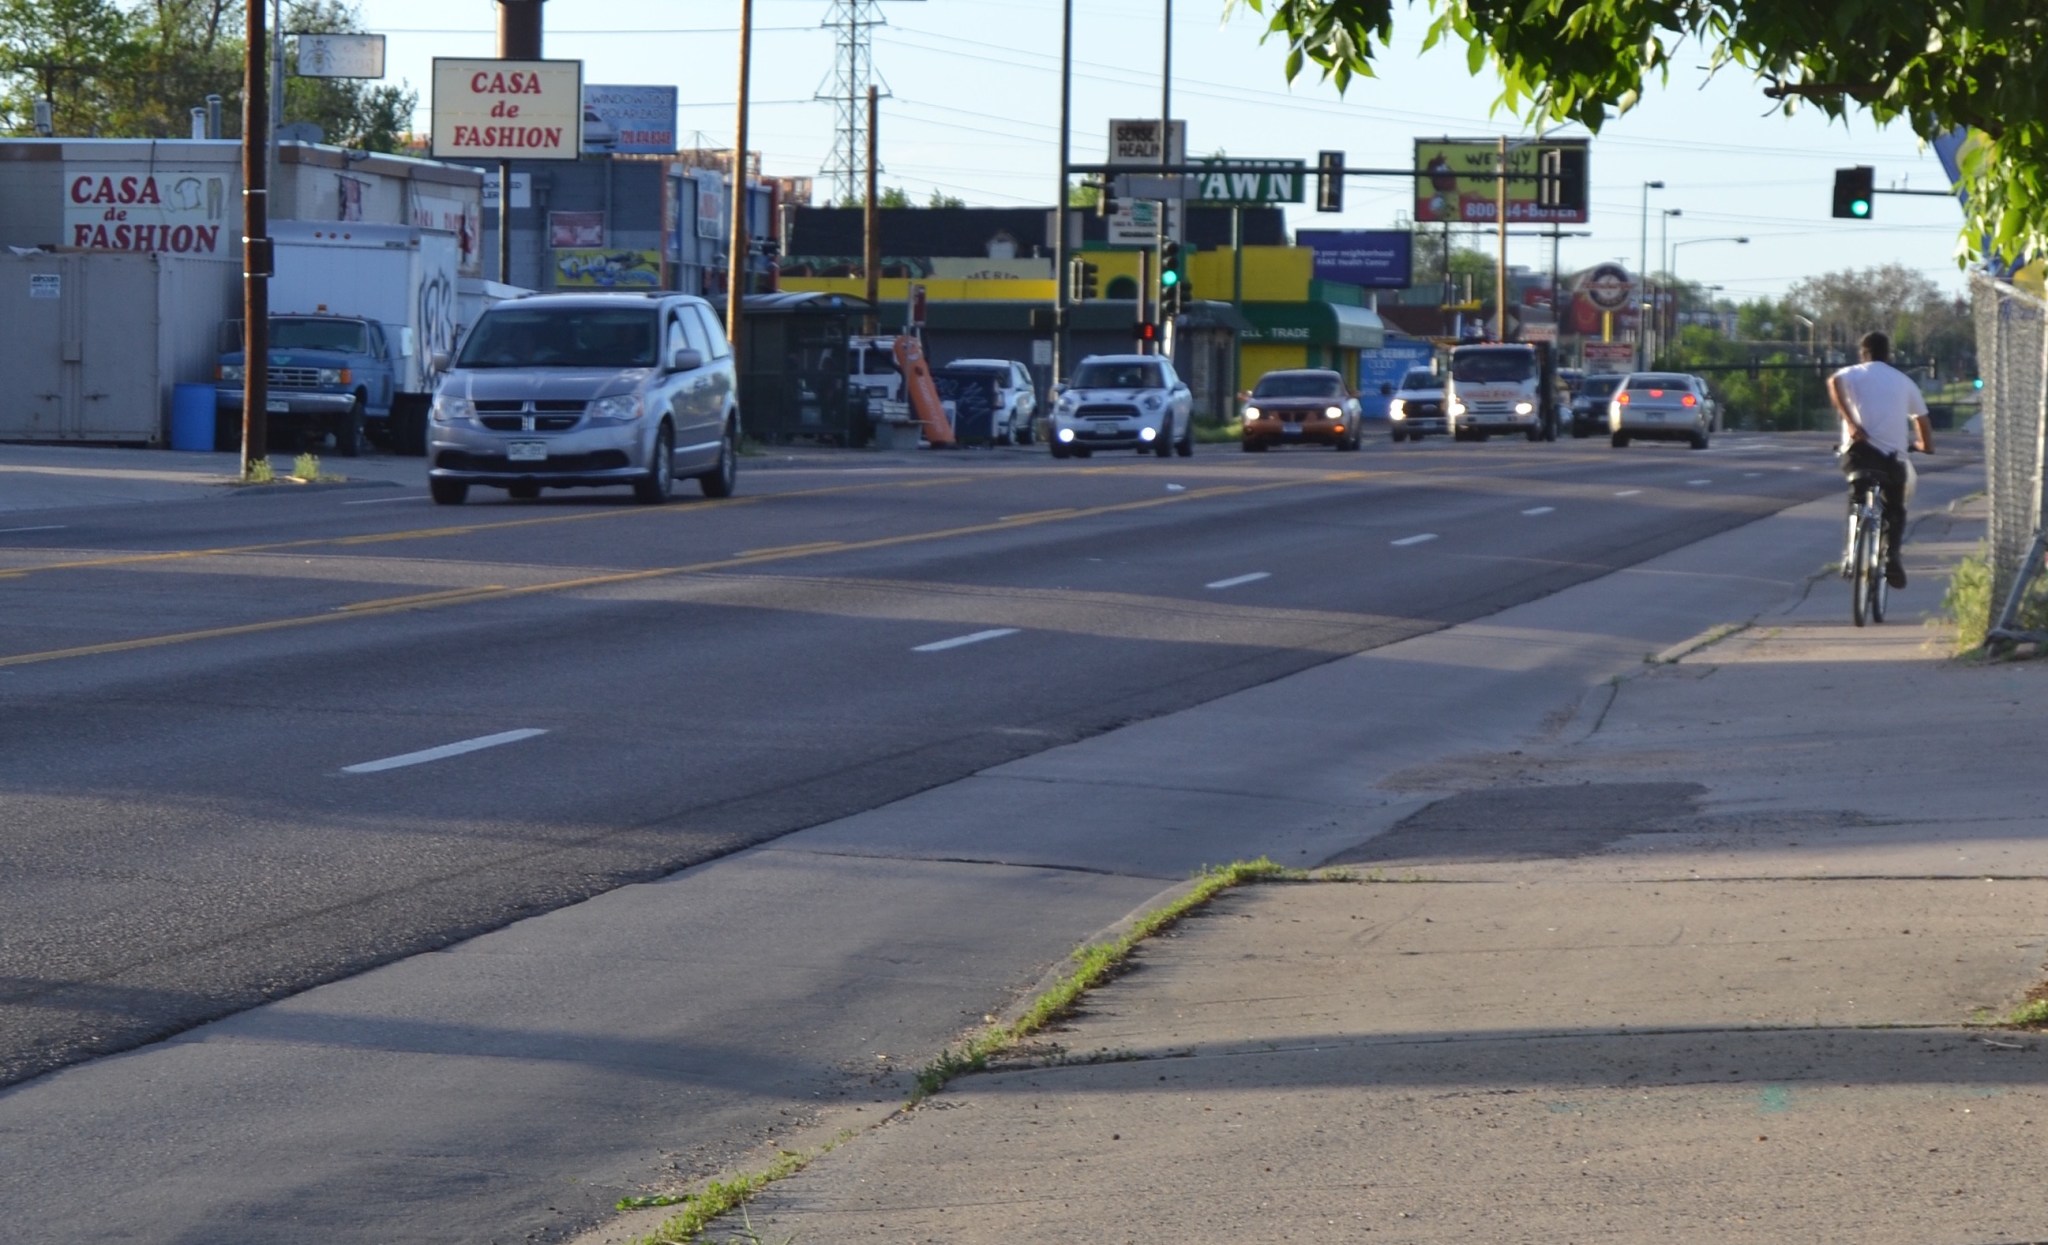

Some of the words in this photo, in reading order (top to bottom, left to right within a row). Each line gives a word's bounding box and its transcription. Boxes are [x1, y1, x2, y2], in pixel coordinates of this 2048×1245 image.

[471, 72, 542, 94] CASA
[592, 93, 643, 104] WINDOW
[490, 100, 519, 118] de
[452, 126, 562, 147] FASHION
[71, 176, 161, 204] CASA
[103, 207, 127, 221] de
[74, 224, 220, 252] FASHION
[1240, 329, 1263, 338] ELL
[1271, 327, 1311, 339] TRADE
